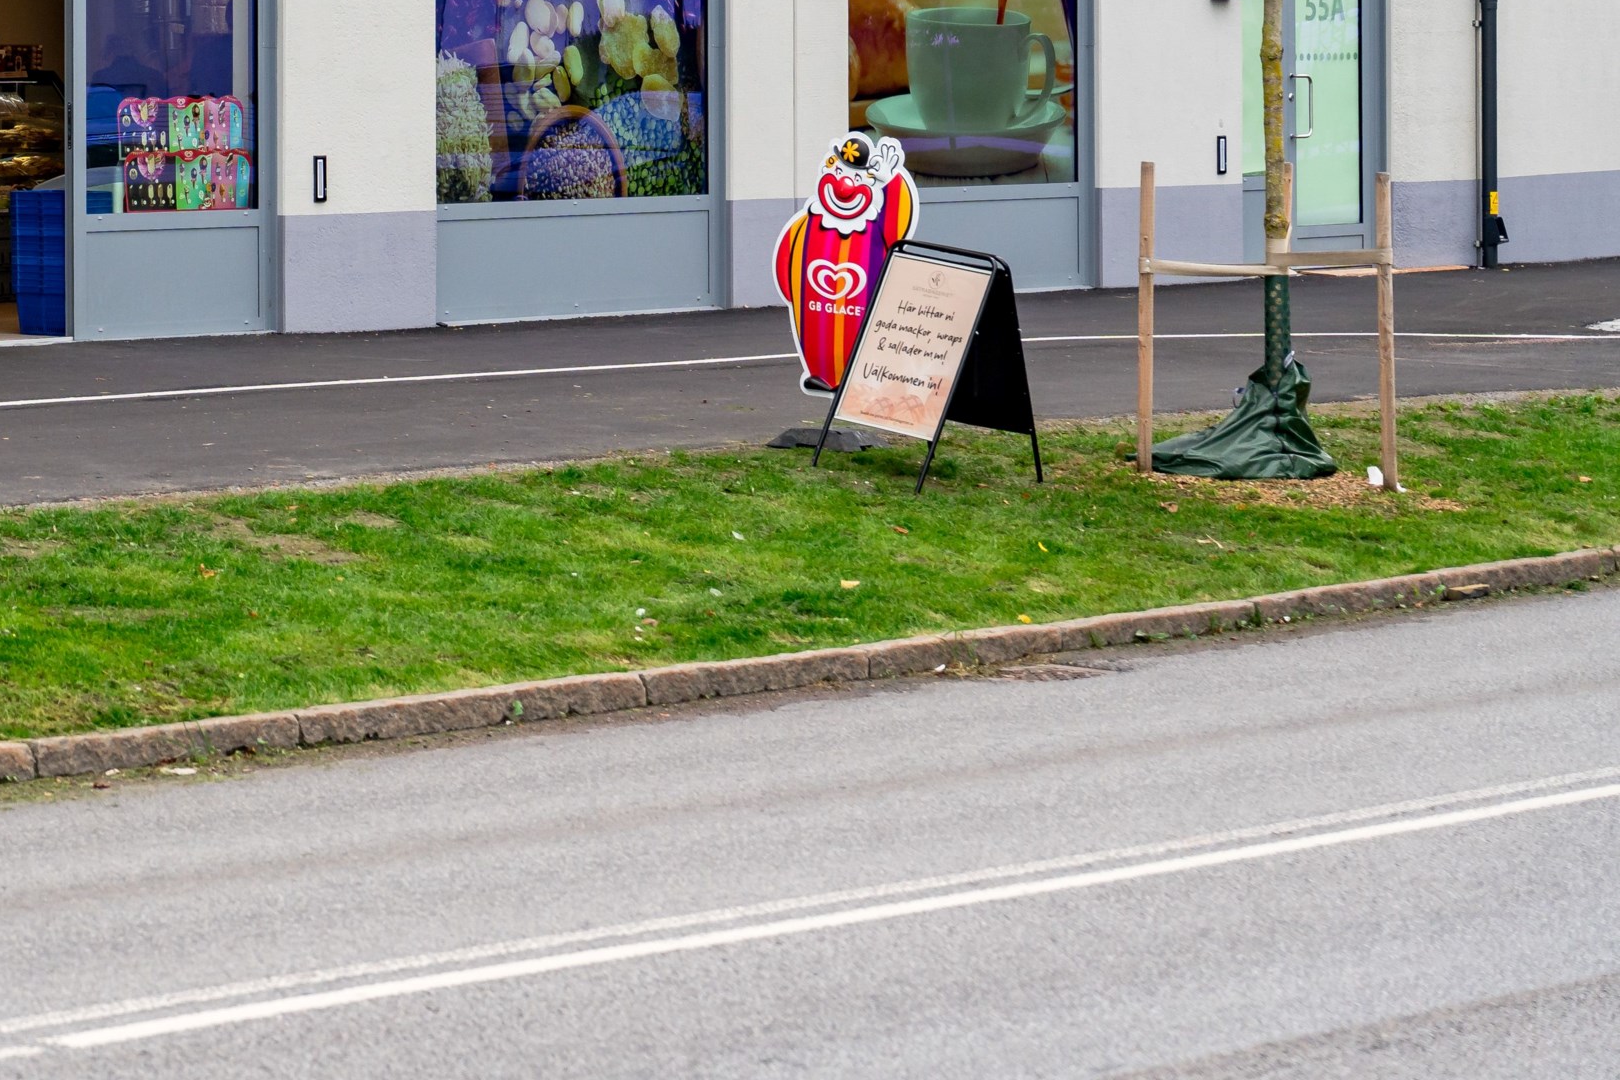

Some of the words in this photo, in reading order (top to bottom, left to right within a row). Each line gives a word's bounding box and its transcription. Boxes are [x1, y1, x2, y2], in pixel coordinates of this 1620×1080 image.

[808, 300, 822, 312] GB
[825, 302, 862, 317] GLACE
[897, 300, 917, 315] Här
[918, 305, 944, 318] hittar
[945, 311, 955, 321] ni
[874, 319, 897, 333] goda
[899, 324, 931, 344] mackor,
[936, 331, 963, 346] wraps
[877, 336, 887, 351] &
[888, 340, 923, 356] sallader
[863, 362, 925, 387] Välkommen
[927, 376, 943, 396] in!
